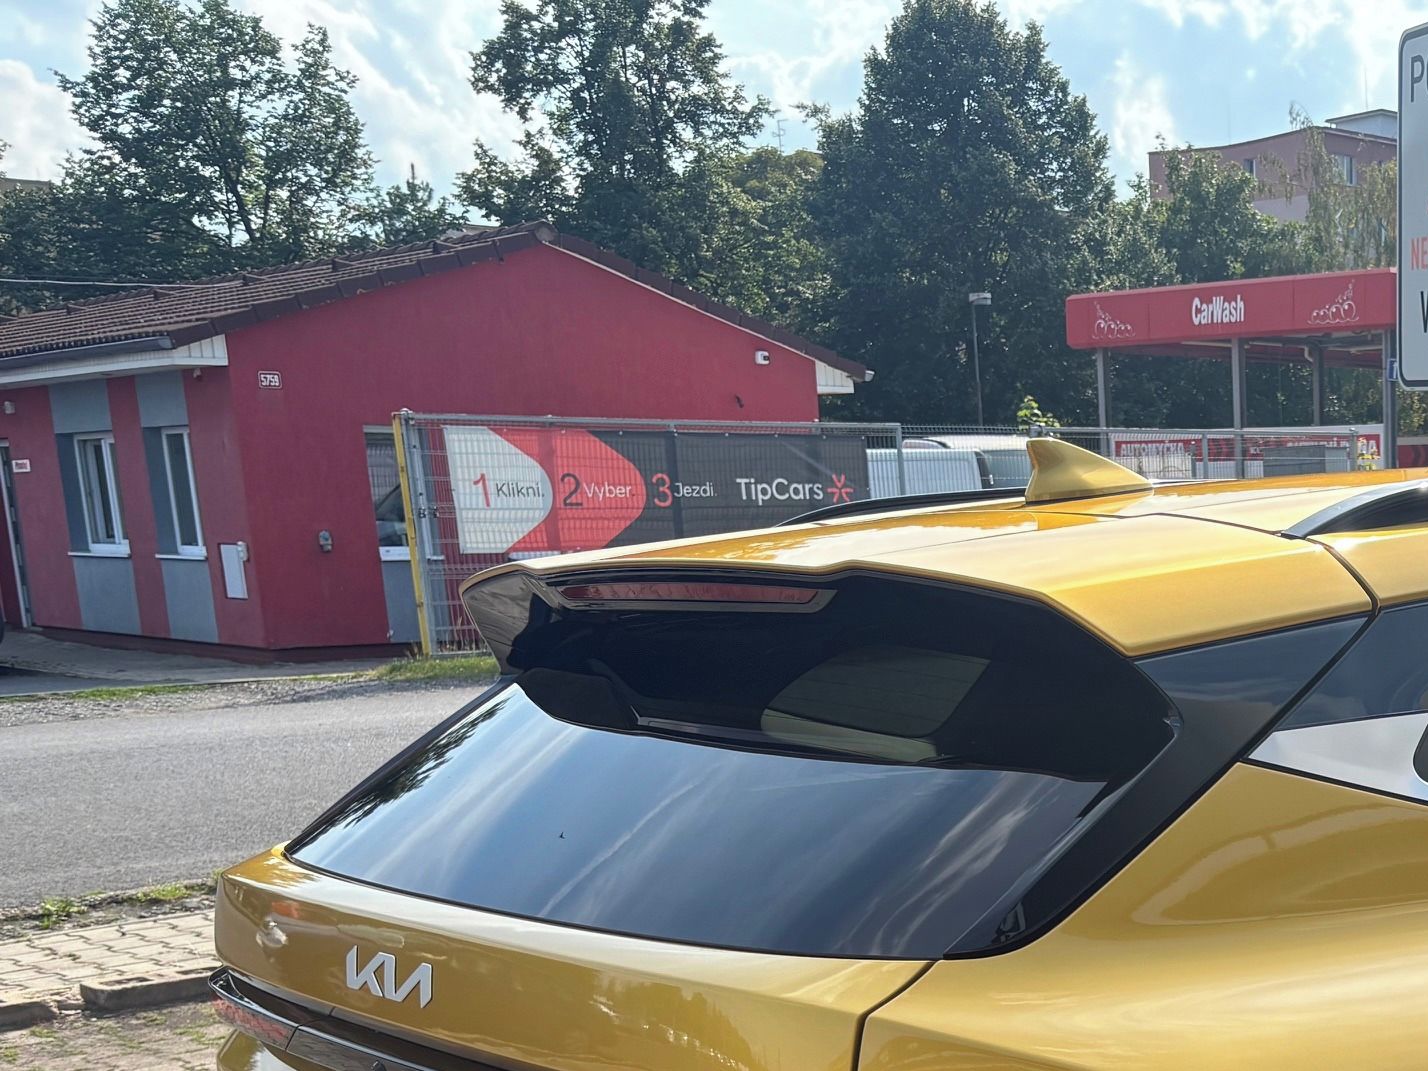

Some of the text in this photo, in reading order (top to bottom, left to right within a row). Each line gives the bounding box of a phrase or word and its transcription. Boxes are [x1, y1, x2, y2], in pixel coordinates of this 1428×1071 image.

[1192, 294, 1245, 326] CarWash
[260, 374, 280, 386] 5759
[473, 472, 490, 508] 1
[560, 472, 584, 507] 2
[652, 472, 673, 508] 3
[736, 476, 824, 506] TipCars
[345, 945, 433, 1009] KIA
